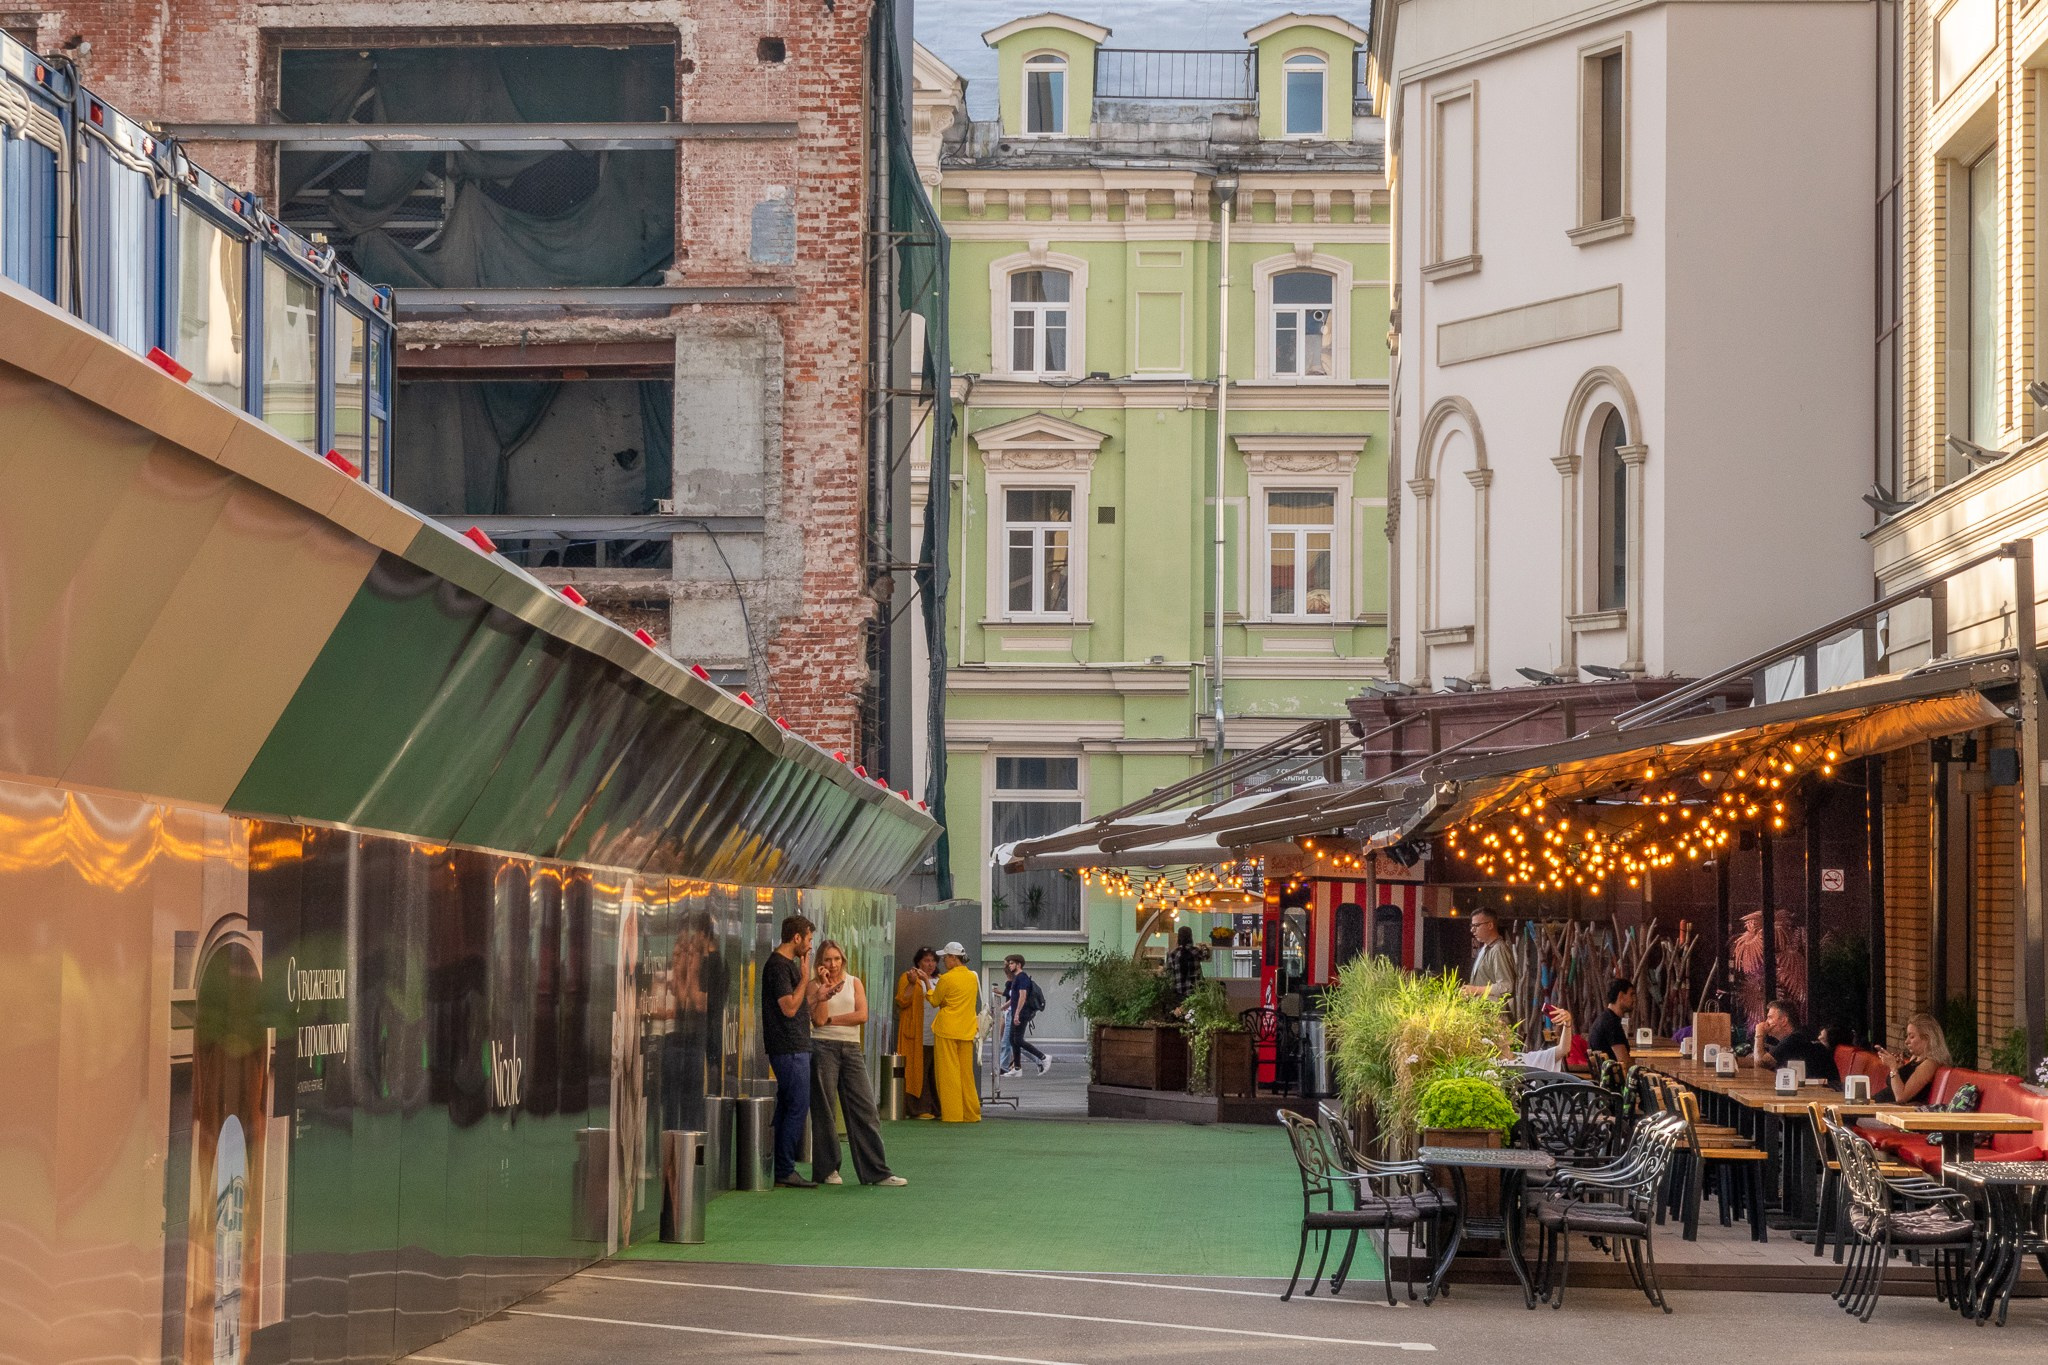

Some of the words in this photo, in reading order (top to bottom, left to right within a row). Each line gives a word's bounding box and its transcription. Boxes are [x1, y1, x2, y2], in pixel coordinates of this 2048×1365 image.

[287, 956, 296, 1003] С
[296, 969, 346, 1013] уважением
[298, 1026, 304, 1058] к
[304, 1023, 350, 1069] прошлому
[491, 1033, 522, 1108] Nicole
